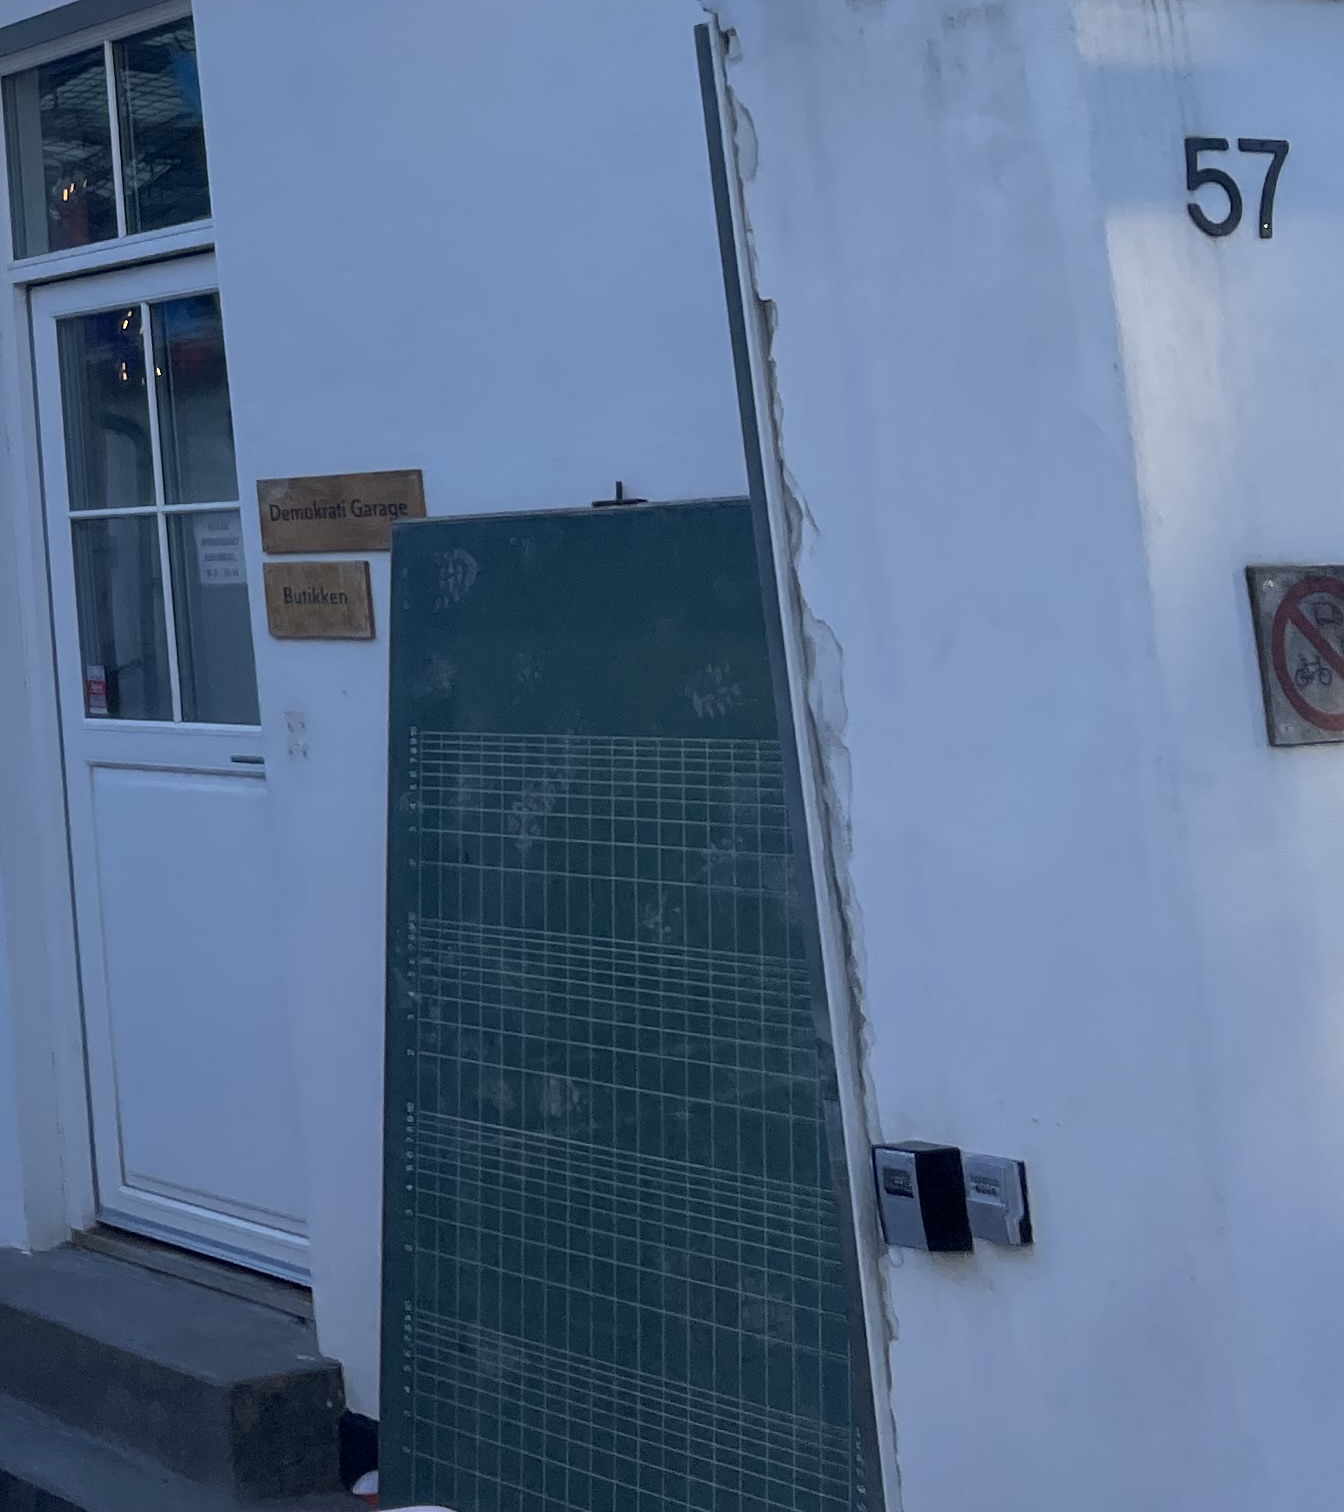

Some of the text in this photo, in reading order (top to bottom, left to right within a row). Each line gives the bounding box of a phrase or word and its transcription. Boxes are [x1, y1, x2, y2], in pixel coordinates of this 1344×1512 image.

[1184, 137, 1289, 239] 57
[269, 499, 408, 522] Demokrati Garage
[283, 586, 348, 605] Butikken
